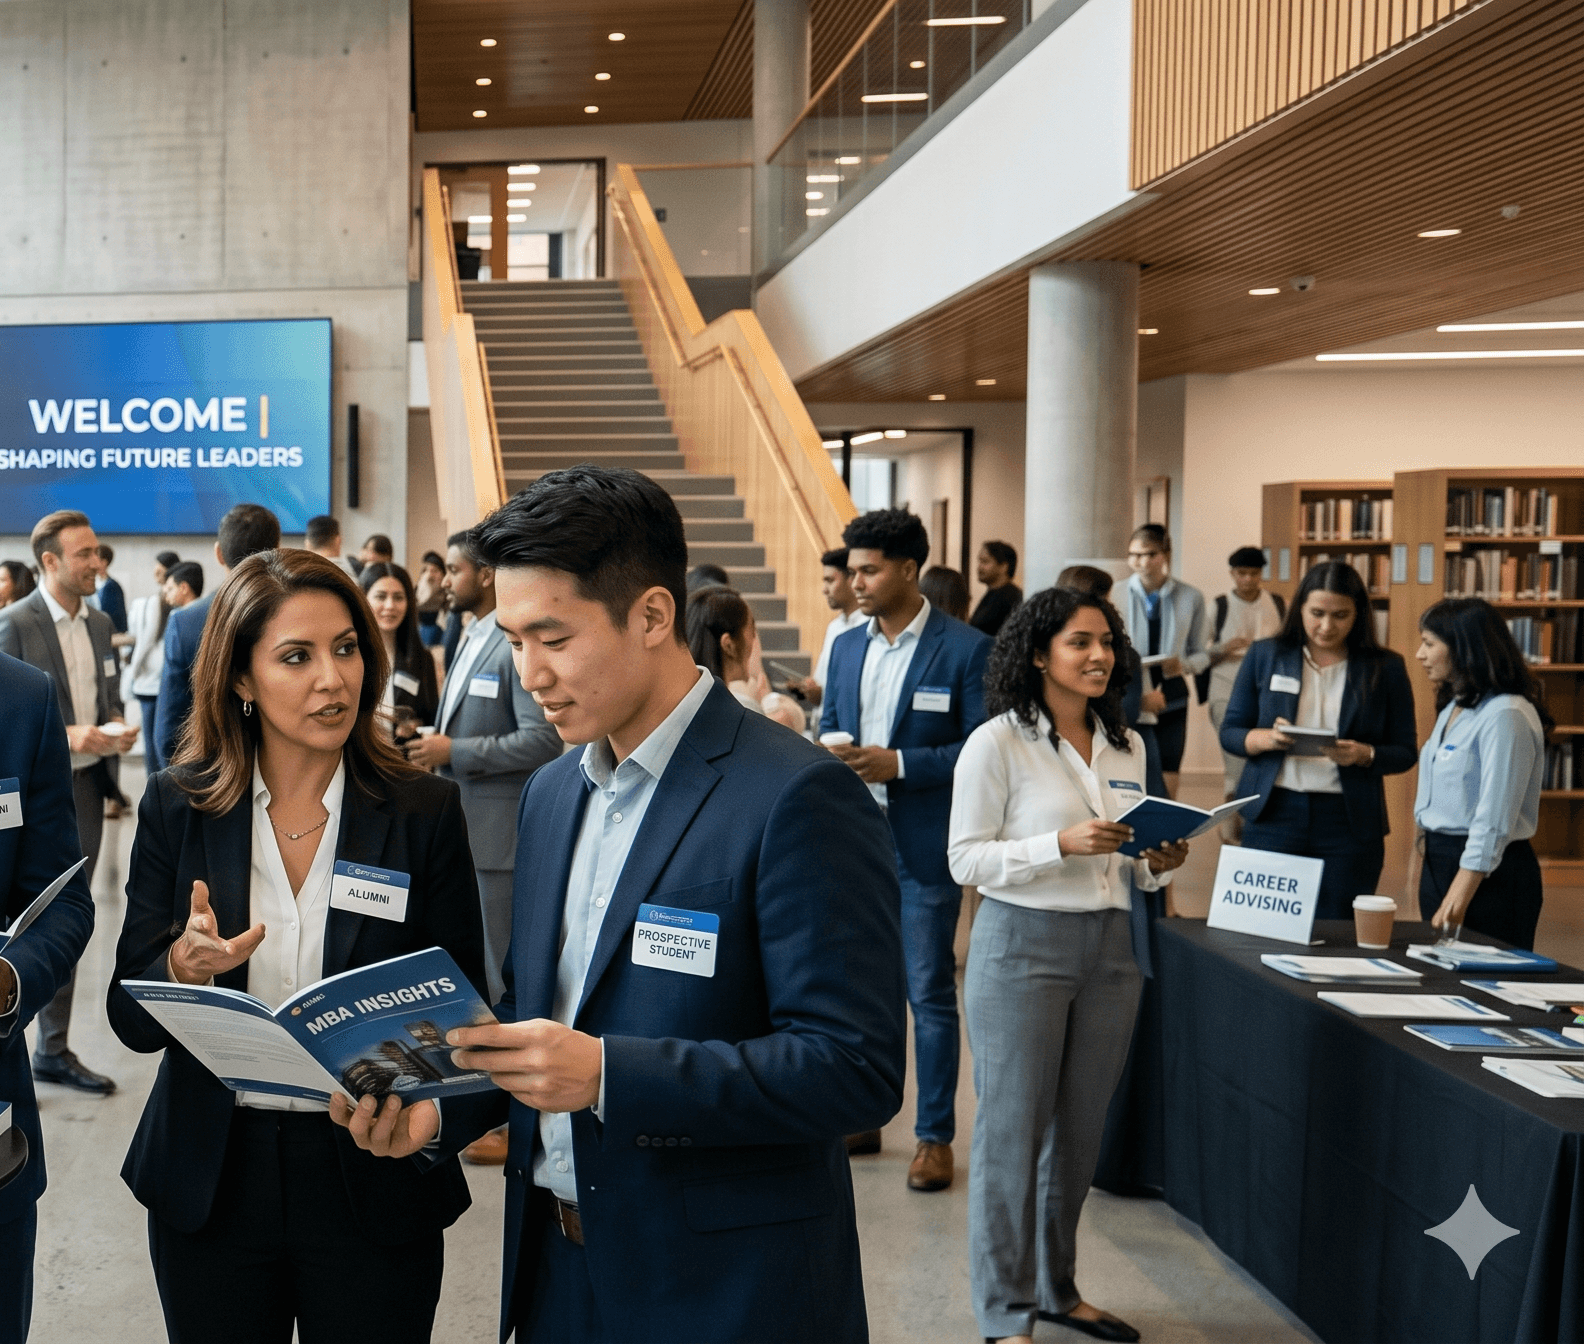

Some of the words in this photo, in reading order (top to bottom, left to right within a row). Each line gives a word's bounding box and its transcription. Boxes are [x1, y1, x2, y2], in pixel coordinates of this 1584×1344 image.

[28, 397, 248, 434] WELCOME
[101, 447, 192, 469] FUTURE
[197, 446, 304, 468] LEADERS
[1233, 870, 1298, 894] CAREER
[347, 888, 390, 905] ALUMNI
[1222, 889, 1303, 916] ADVISING
[638, 928, 711, 950] PROSPECTIVE
[649, 944, 697, 960] STUDENT
[305, 1007, 355, 1035] MBA
[354, 976, 457, 1014] INSIGHTS
